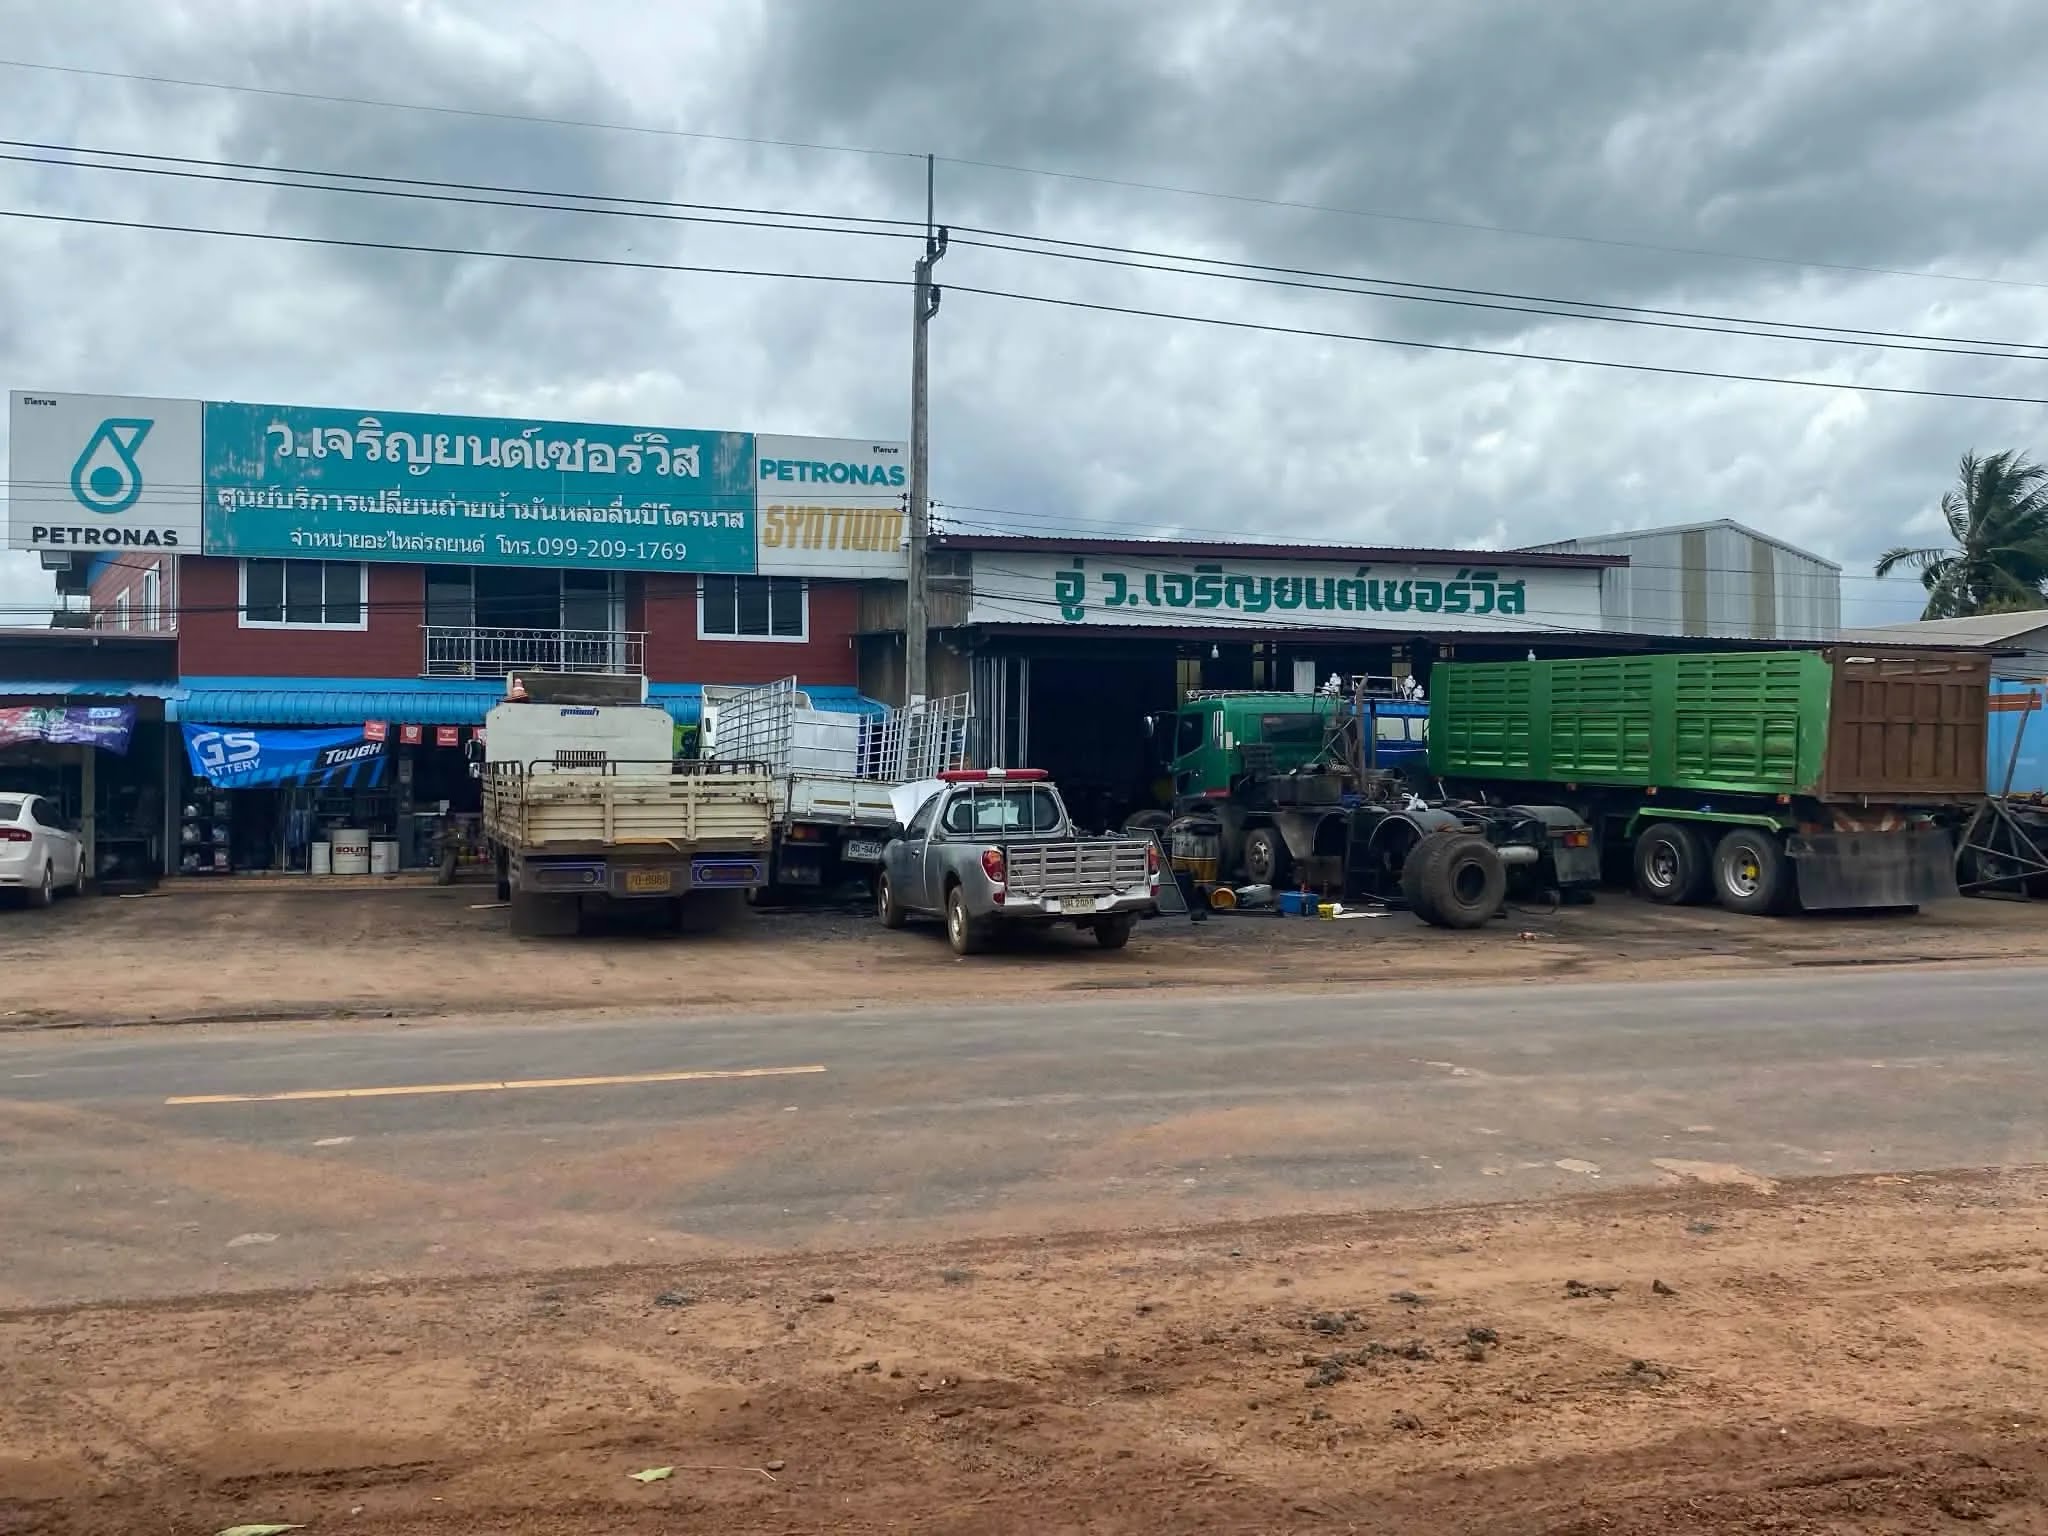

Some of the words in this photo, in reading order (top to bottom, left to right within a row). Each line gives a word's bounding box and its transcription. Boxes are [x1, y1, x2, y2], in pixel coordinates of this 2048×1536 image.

[266, 417, 700, 477] ว.เจริญยนต์เซอร์วิส
[760, 458, 905, 486] PETRONAS
[32, 526, 178, 546] PETRONAS
[289, 527, 485, 553] จำหน่ายอะไหล่รถยนต์
[763, 505, 903, 552] SYNTIUM
[1055, 558, 1085, 620] อู่
[1102, 564, 1526, 616] ว.เจริญยนต์เซอร์วิส
[192, 731, 260, 767] GS
[325, 743, 383, 765] TOUGH
[205, 758, 261, 777] ATTERY
